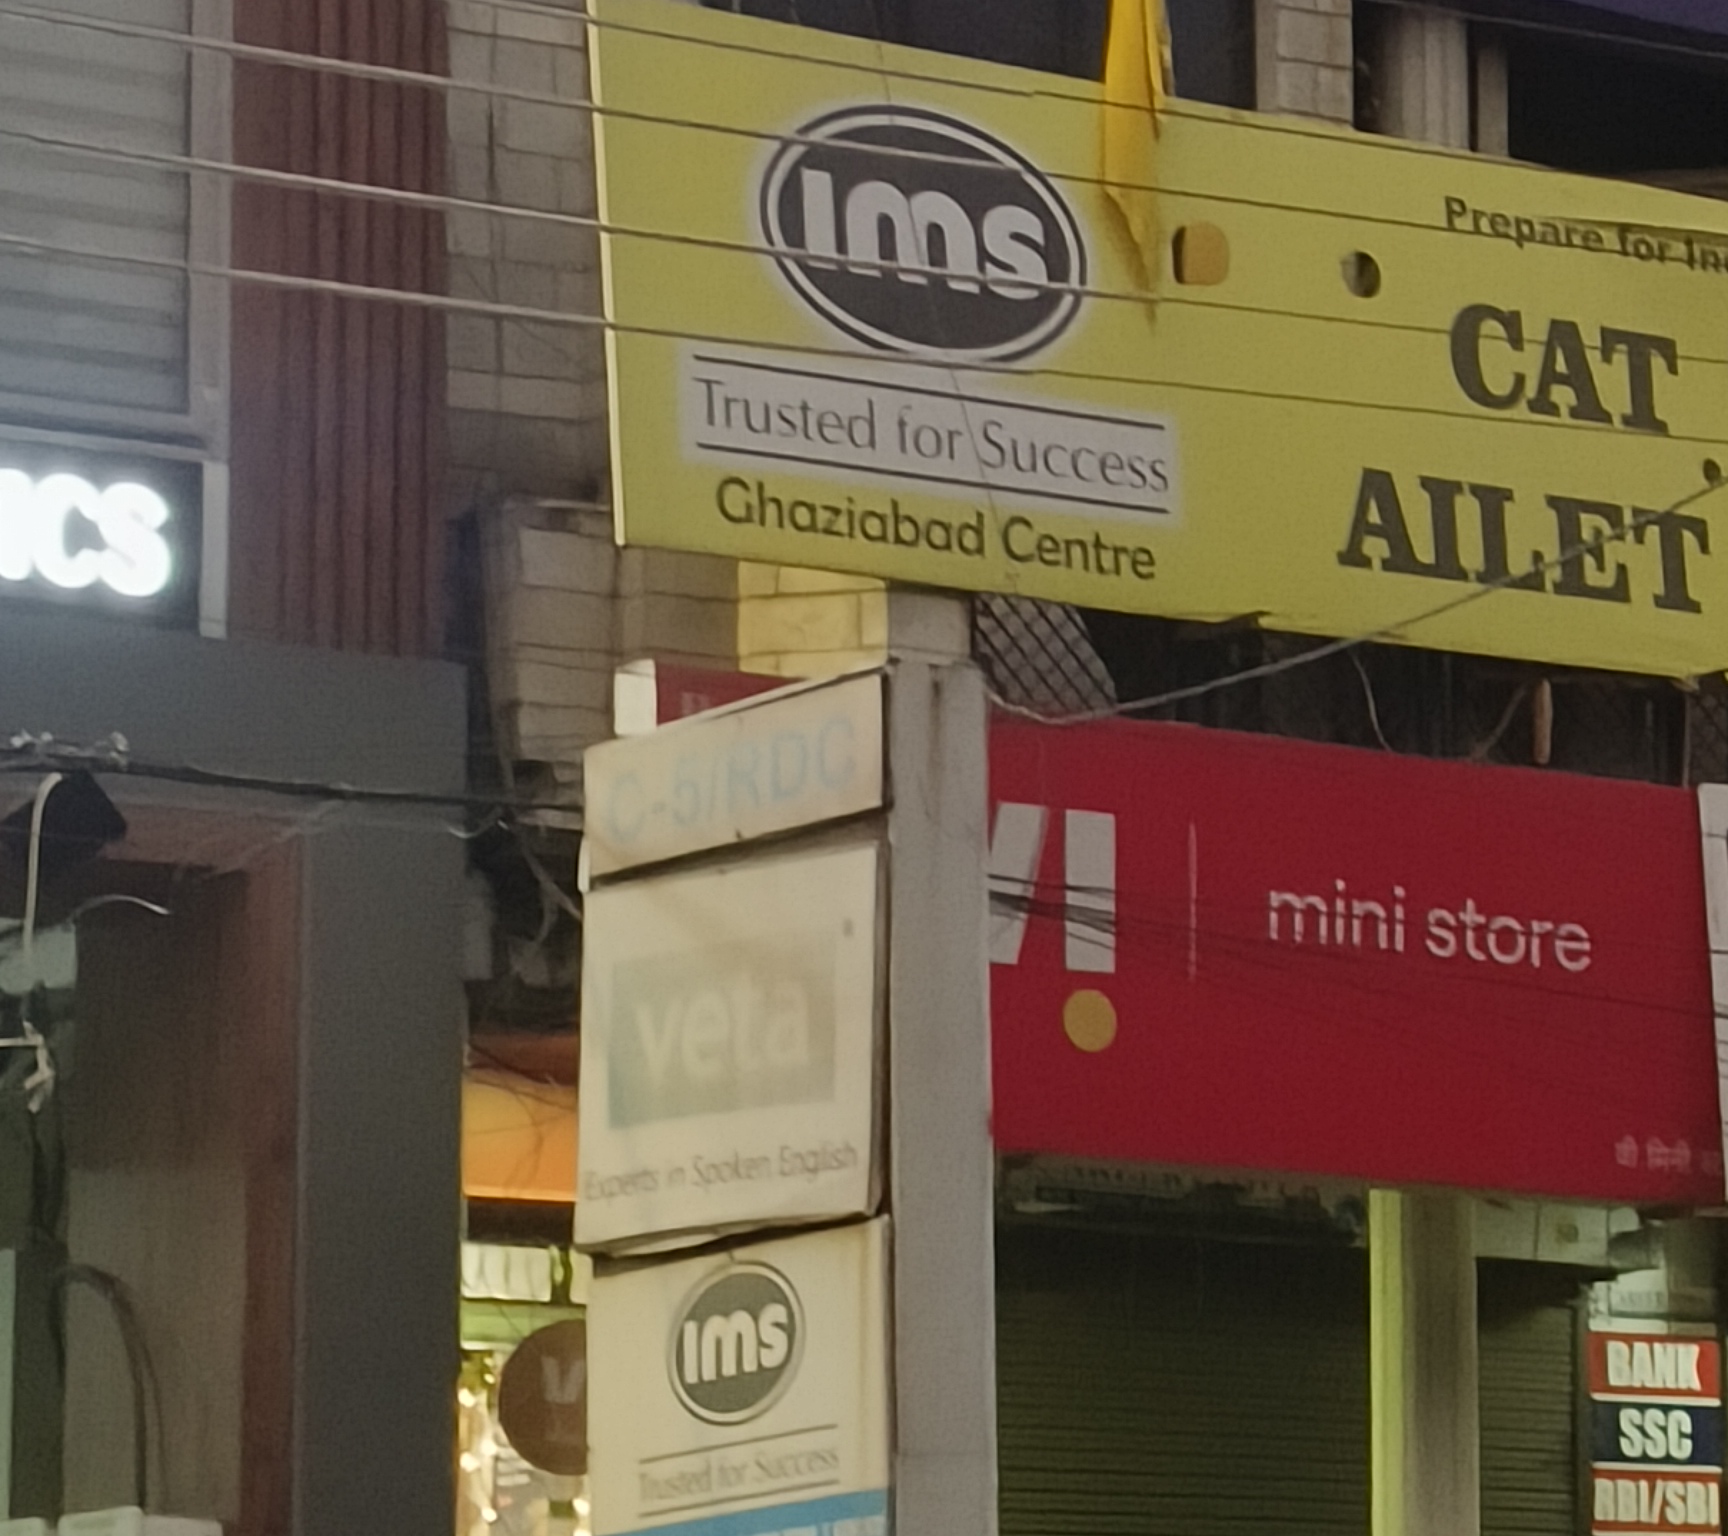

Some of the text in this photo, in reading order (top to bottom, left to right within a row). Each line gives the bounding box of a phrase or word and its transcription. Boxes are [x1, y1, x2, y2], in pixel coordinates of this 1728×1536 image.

[800, 166, 1050, 301] ims
[1444, 195, 1603, 252] Prepare
[1617, 226, 1669, 264] for
[1450, 303, 1679, 437] CAT
[693, 376, 1170, 494] Trusted for Success
[715, 476, 1157, 580] Ghaziabad Centre
[1337, 466, 1710, 615] AILET
[1268, 878, 1592, 973] mini store
[683, 1302, 790, 1385] ims
[1606, 1340, 1701, 1391] BANK
[1619, 1408, 1693, 1459] SSC
